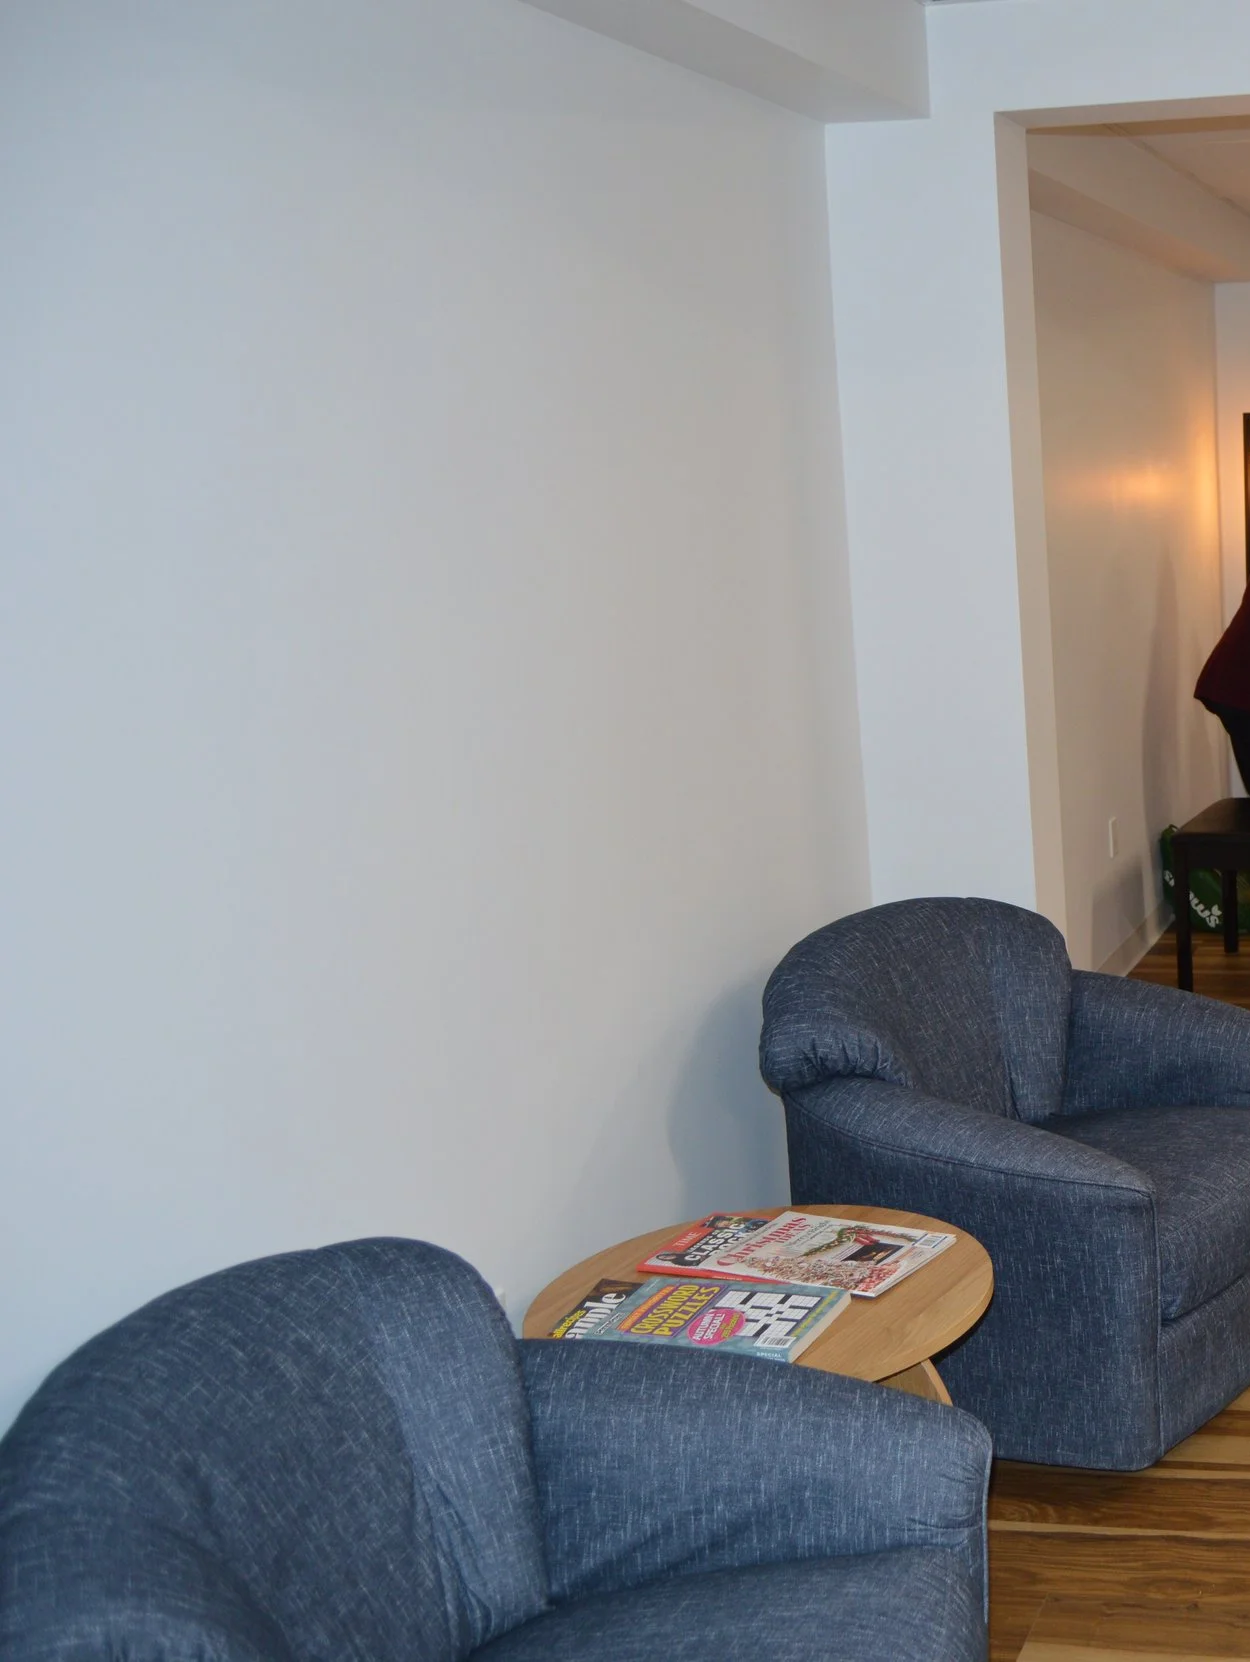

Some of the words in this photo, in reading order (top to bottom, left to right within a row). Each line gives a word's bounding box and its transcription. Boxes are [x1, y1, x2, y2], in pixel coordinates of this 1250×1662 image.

[672, 1231, 701, 1248] TIME
[684, 1223, 745, 1261] CLASSIC
[716, 1217, 807, 1266] Christmas
[775, 1223, 811, 1244] IDEAS
[630, 1284, 700, 1334] CROSSWORD
[652, 1285, 721, 1336] PUZZLES
